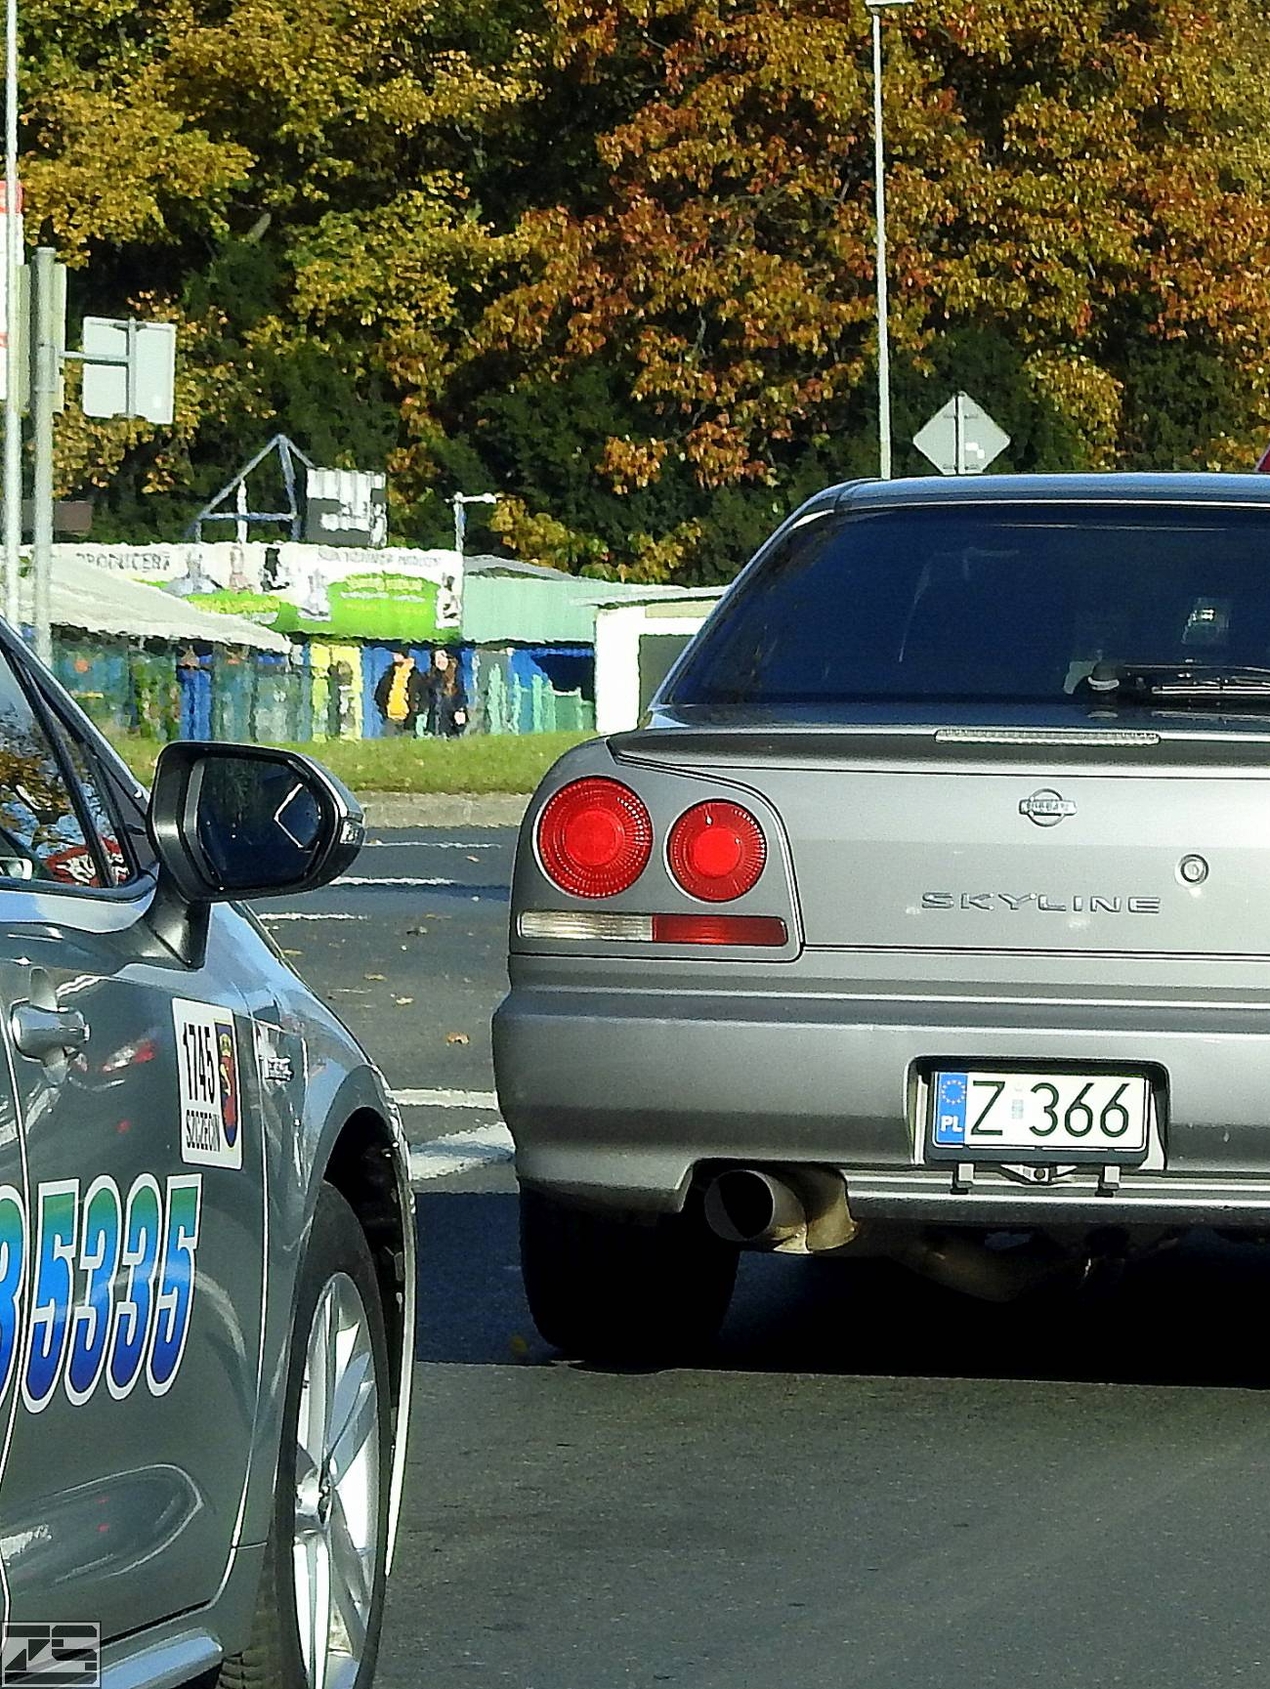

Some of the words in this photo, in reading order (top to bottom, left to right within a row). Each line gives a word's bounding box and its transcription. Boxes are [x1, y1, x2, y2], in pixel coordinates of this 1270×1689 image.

[922, 892, 1160, 914] SKYLINE
[183, 1021, 216, 1104] 1745
[940, 1115, 964, 1133] PL
[971, 1080, 1006, 1136] Z
[1029, 1082, 1131, 1138] 366
